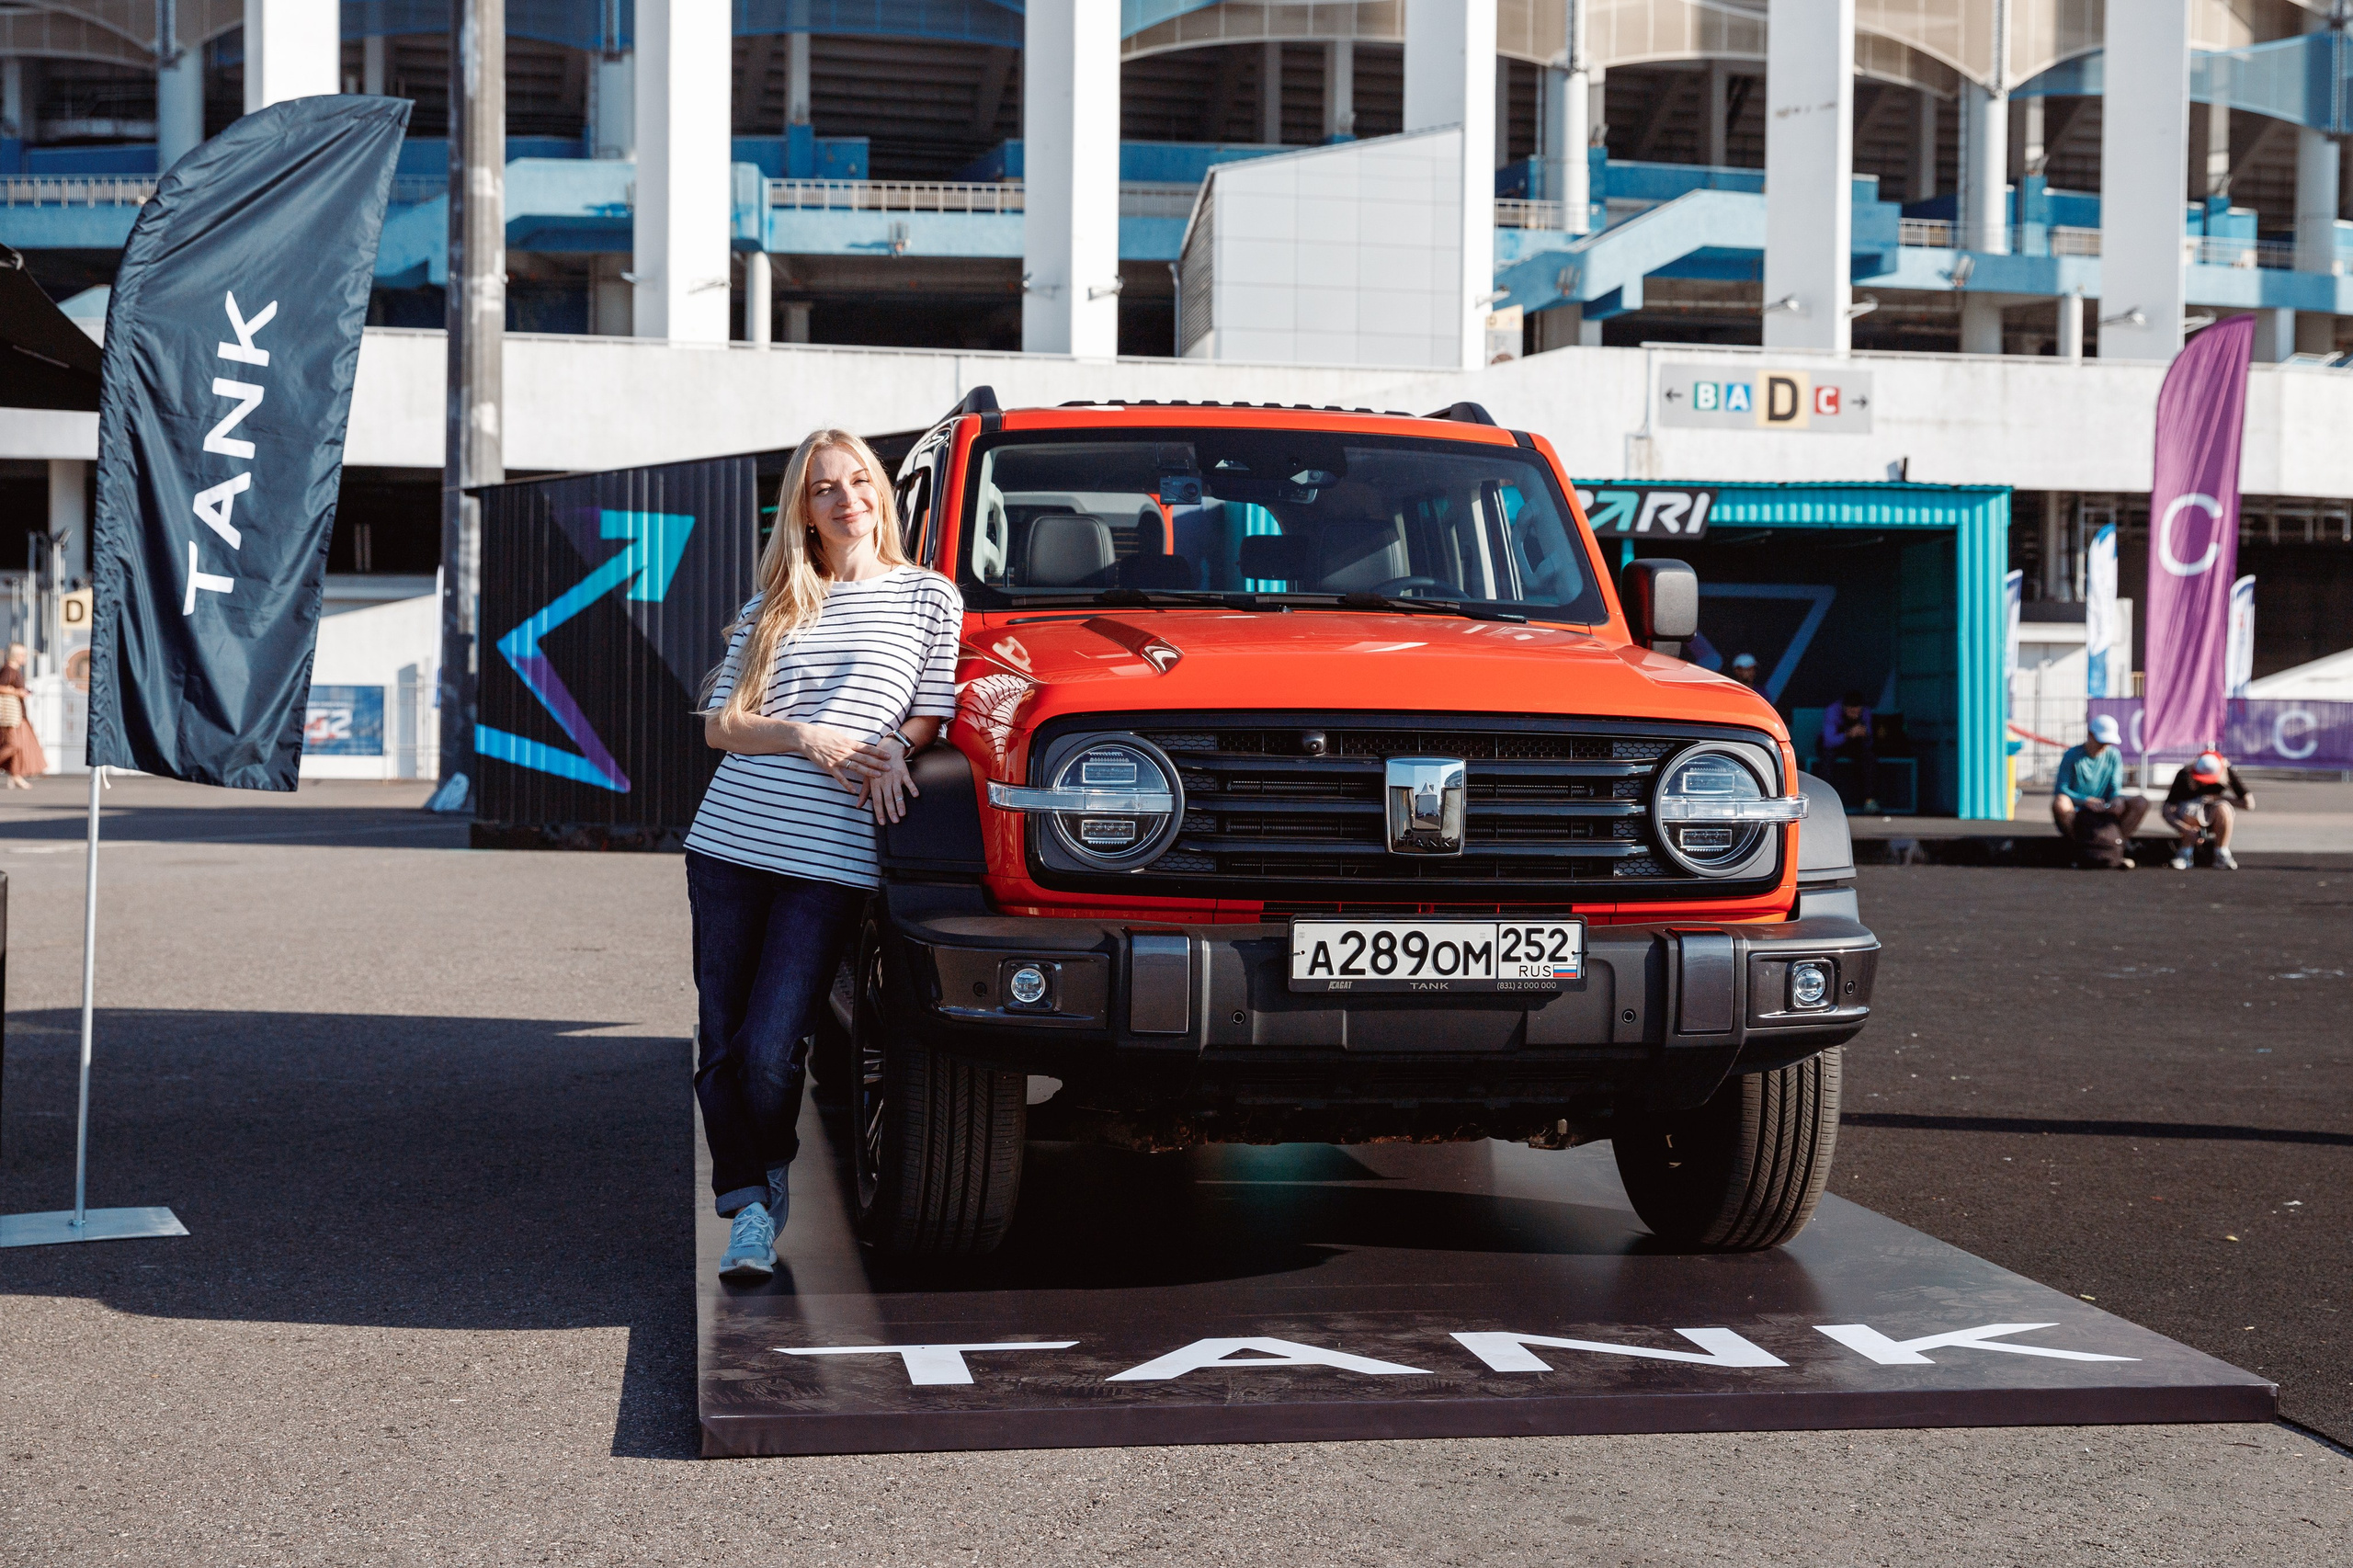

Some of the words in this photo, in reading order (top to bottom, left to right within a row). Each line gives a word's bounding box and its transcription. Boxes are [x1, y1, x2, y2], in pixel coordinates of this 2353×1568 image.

[1699, 382, 1717, 410] B
[1727, 384, 1749, 411] A
[1768, 376, 1799, 421] D
[1817, 387, 1837, 414] C
[182, 290, 278, 617] TANK
[2157, 492, 2223, 577] C
[66, 599, 84, 622] D
[2273, 709, 2319, 760] C
[1308, 929, 1492, 976] A289OM
[1501, 926, 1569, 963] 252
[1519, 964, 1552, 978] RUS
[1409, 982, 1449, 991] TANK
[1496, 982, 1516, 991] (831)
[771, 1323, 2143, 1386] TANK
